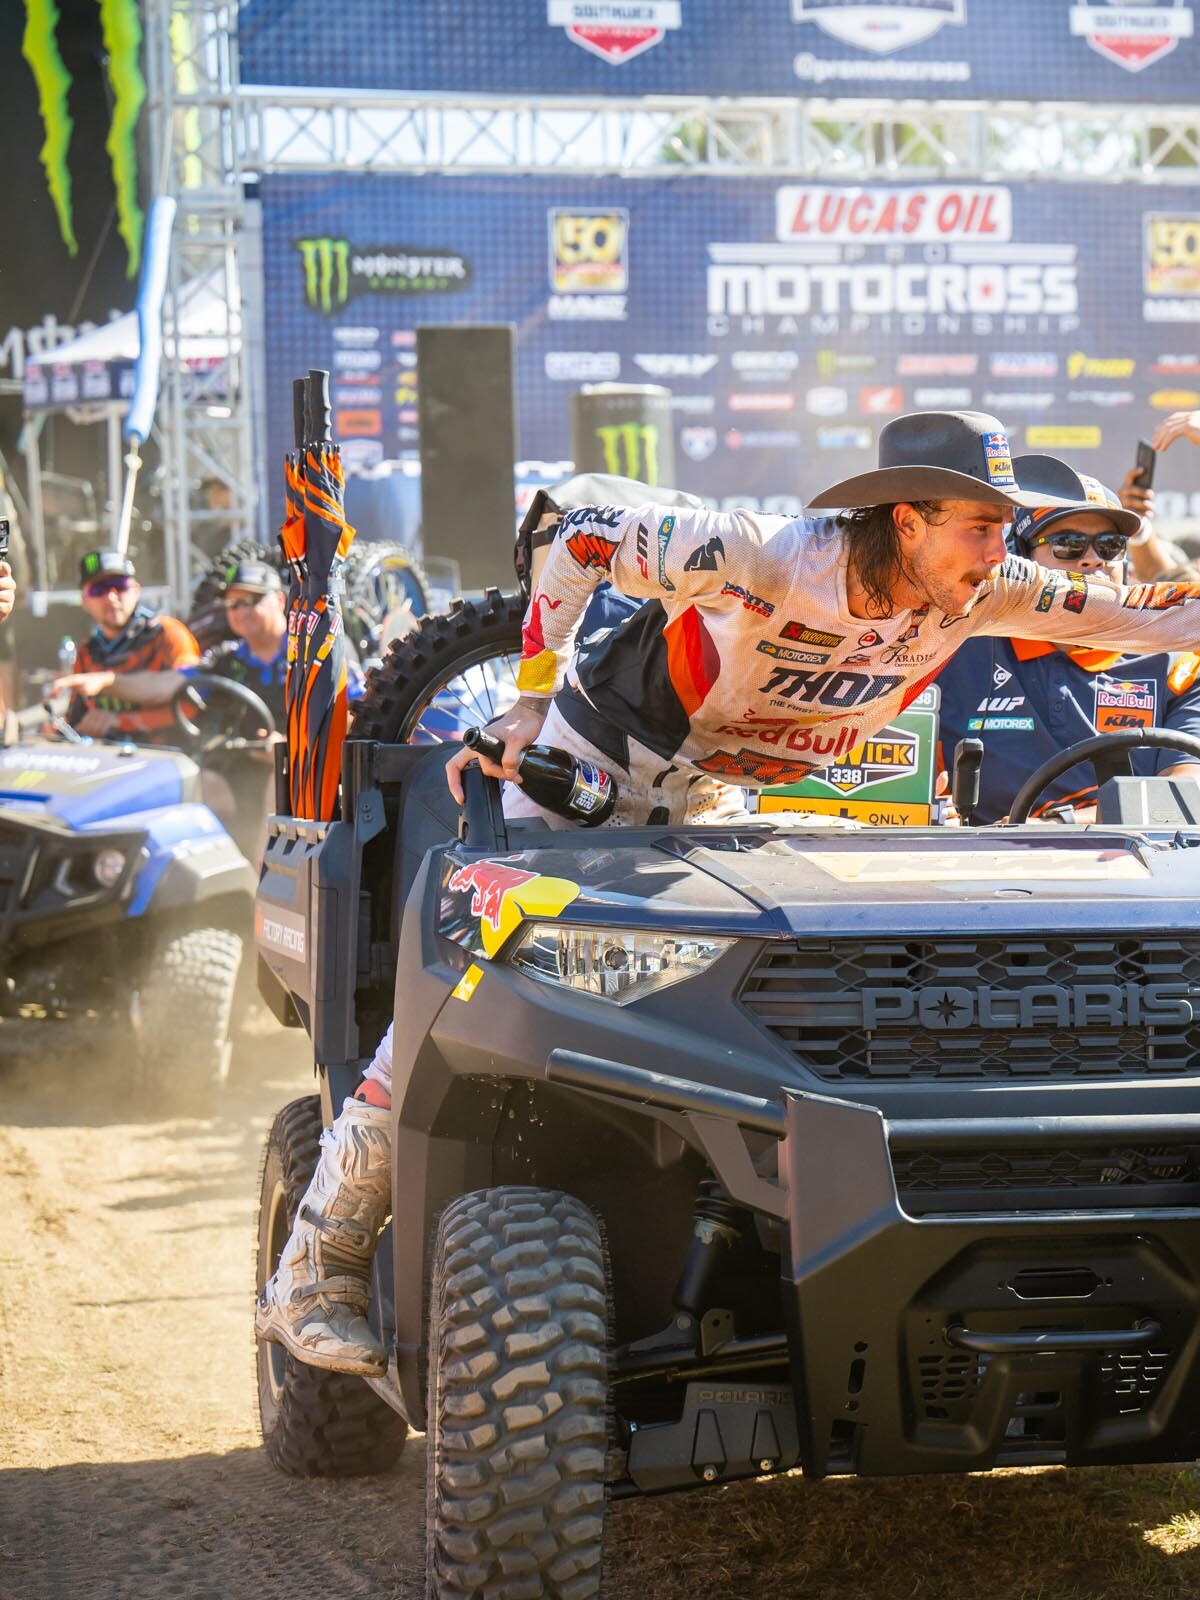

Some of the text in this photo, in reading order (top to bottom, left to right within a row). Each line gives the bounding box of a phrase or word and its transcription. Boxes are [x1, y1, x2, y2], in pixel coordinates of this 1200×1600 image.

[791, 194, 999, 232] LUCAS OIL
[557, 216, 622, 262] 50
[844, 244, 947, 262] PRO
[352, 254, 465, 280] MONSTER
[707, 264, 1078, 315] MOTOCROSS
[707, 316, 1080, 335] CHAMPIONSHIP
[777, 648, 825, 664] MOTOREX
[769, 699, 785, 708] THE
[787, 704, 816, 715] FIRST
[1098, 691, 1153, 710] Red Bull
[984, 717, 1033, 730] MOTOREX
[1103, 713, 1145, 727] KTM
[715, 725, 861, 758] Red Bull
[830, 768, 862, 784] 338
[868, 813, 911, 826] ONLY
[861, 983, 1193, 1031] POLARIS
